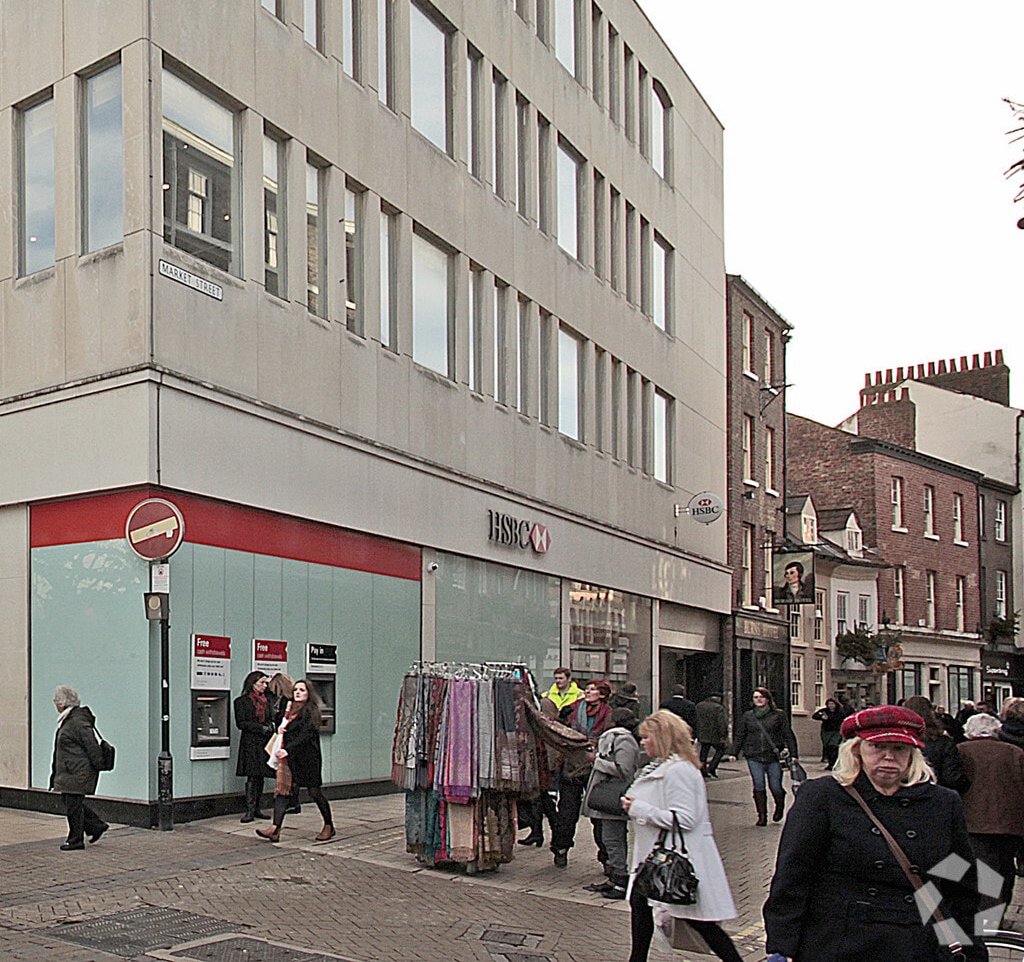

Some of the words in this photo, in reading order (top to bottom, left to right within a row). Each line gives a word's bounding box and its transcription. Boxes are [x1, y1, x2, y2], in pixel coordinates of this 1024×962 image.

[161, 263, 192, 285] MARKET
[195, 278, 221, 297] STREET
[692, 505, 720, 516] HSBC
[488, 509, 530, 549] HSBC
[196, 637, 210, 648] Free
[257, 642, 269, 652] Free
[319, 647, 325, 655] in
